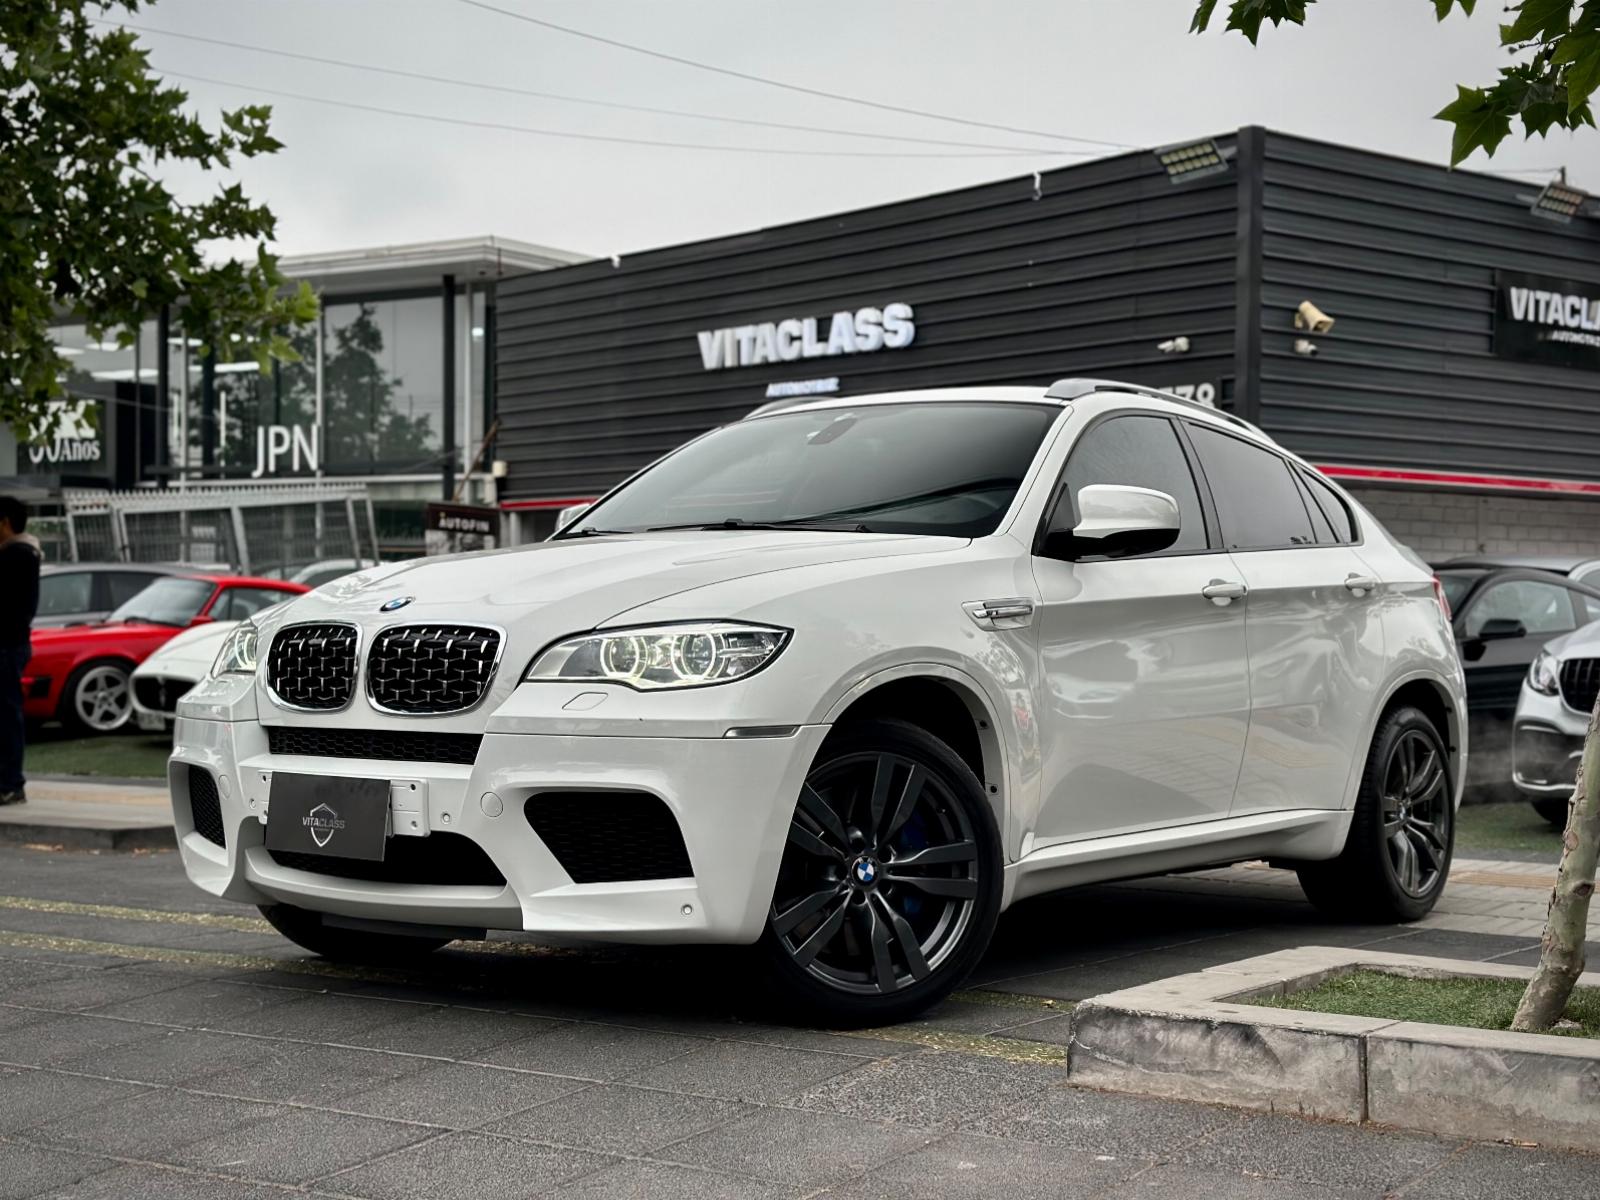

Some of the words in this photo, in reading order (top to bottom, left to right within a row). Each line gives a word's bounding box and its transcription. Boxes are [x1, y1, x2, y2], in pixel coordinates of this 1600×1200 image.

[697, 302, 915, 370] VITACLASS
[251, 423, 318, 478] JPN
[302, 816, 345, 829] VITACLASS
